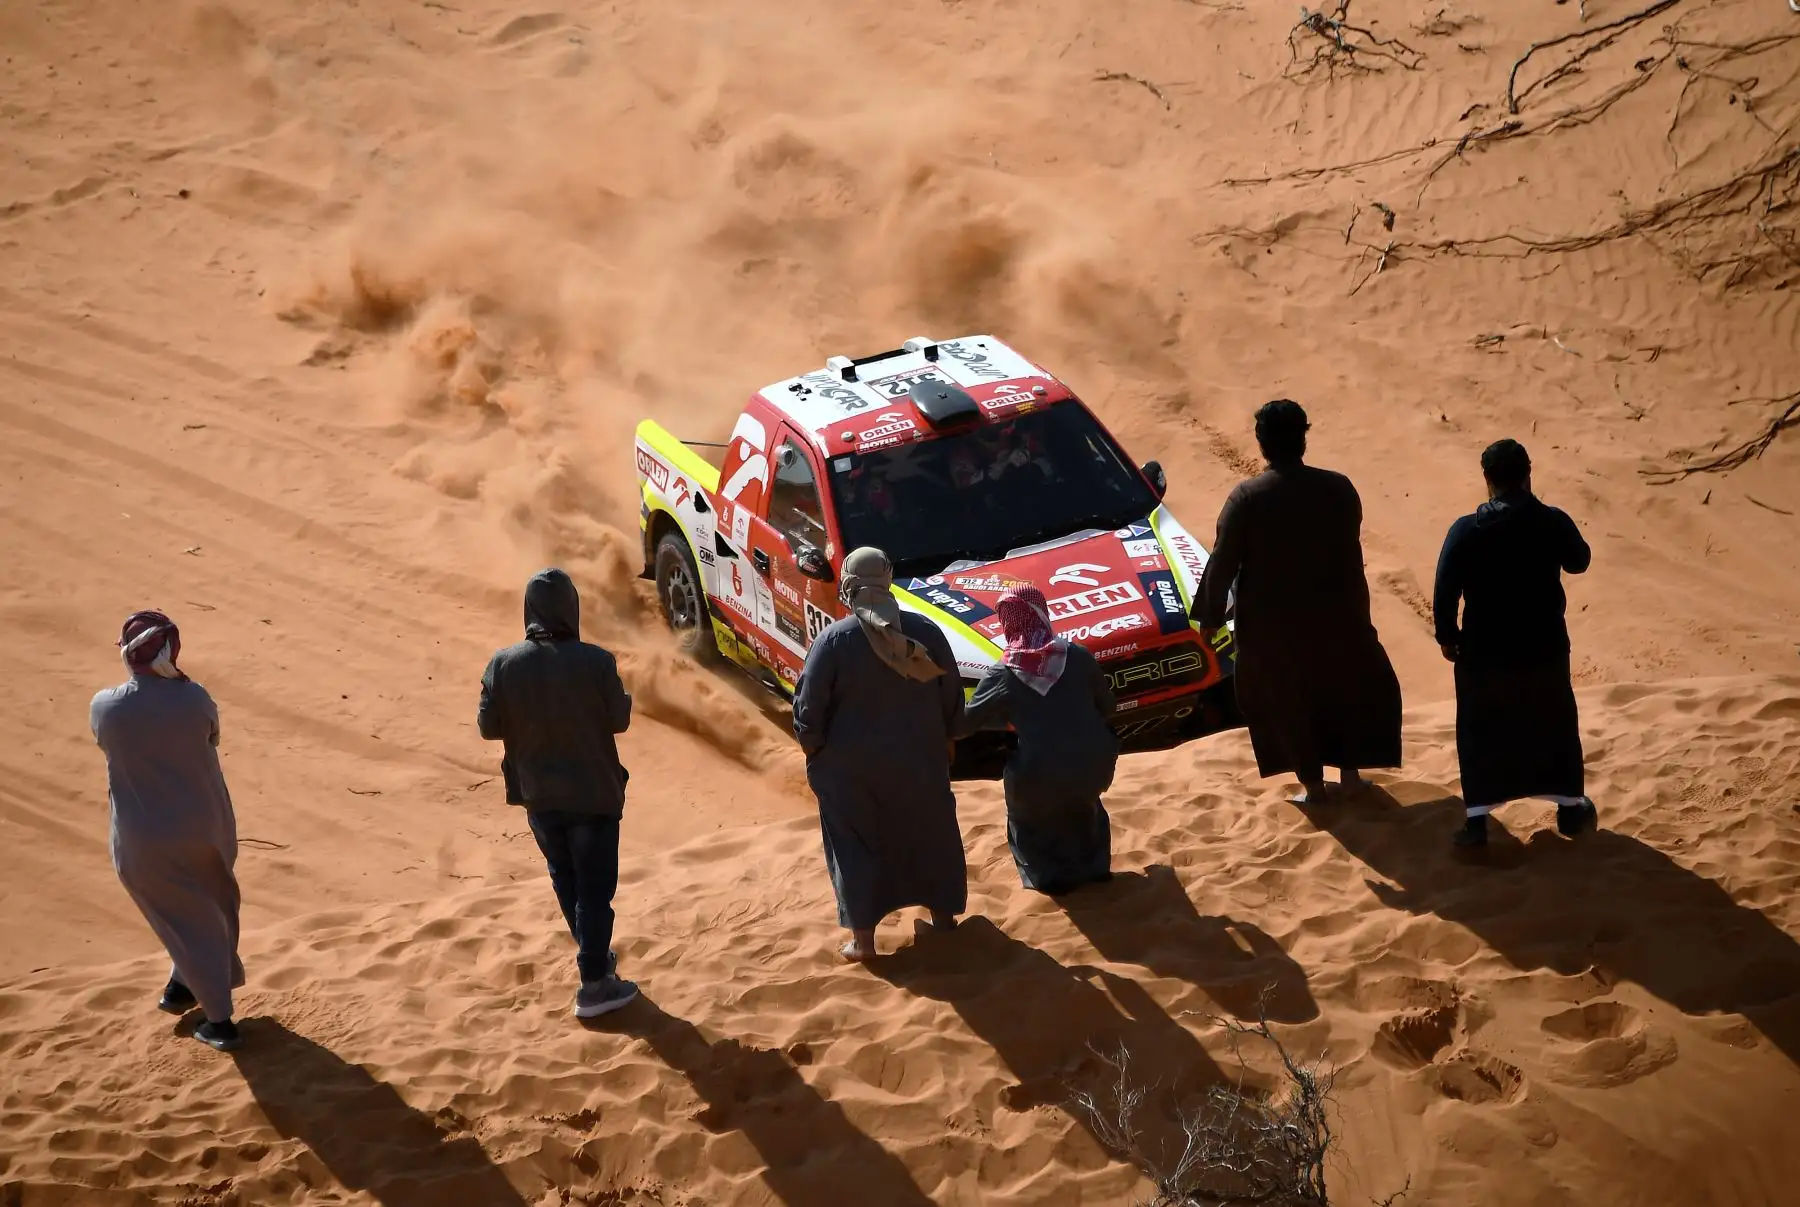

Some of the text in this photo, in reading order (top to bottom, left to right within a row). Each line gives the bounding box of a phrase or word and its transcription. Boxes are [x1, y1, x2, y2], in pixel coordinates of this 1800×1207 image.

[987, 393, 1031, 407] ORLEN
[863, 421, 911, 438] ORLEN
[859, 436, 898, 450] MOTUL
[638, 452, 668, 489] ORLEN
[700, 549, 715, 562] OMP
[774, 578, 799, 605] MOTUL
[926, 589, 972, 613] verva
[1046, 585, 1132, 617] RLEN
[1156, 580, 1181, 613] verva
[725, 594, 753, 620] BENZINA
[1094, 642, 1138, 660] BENZINA
[956, 660, 991, 670] BENZIN
